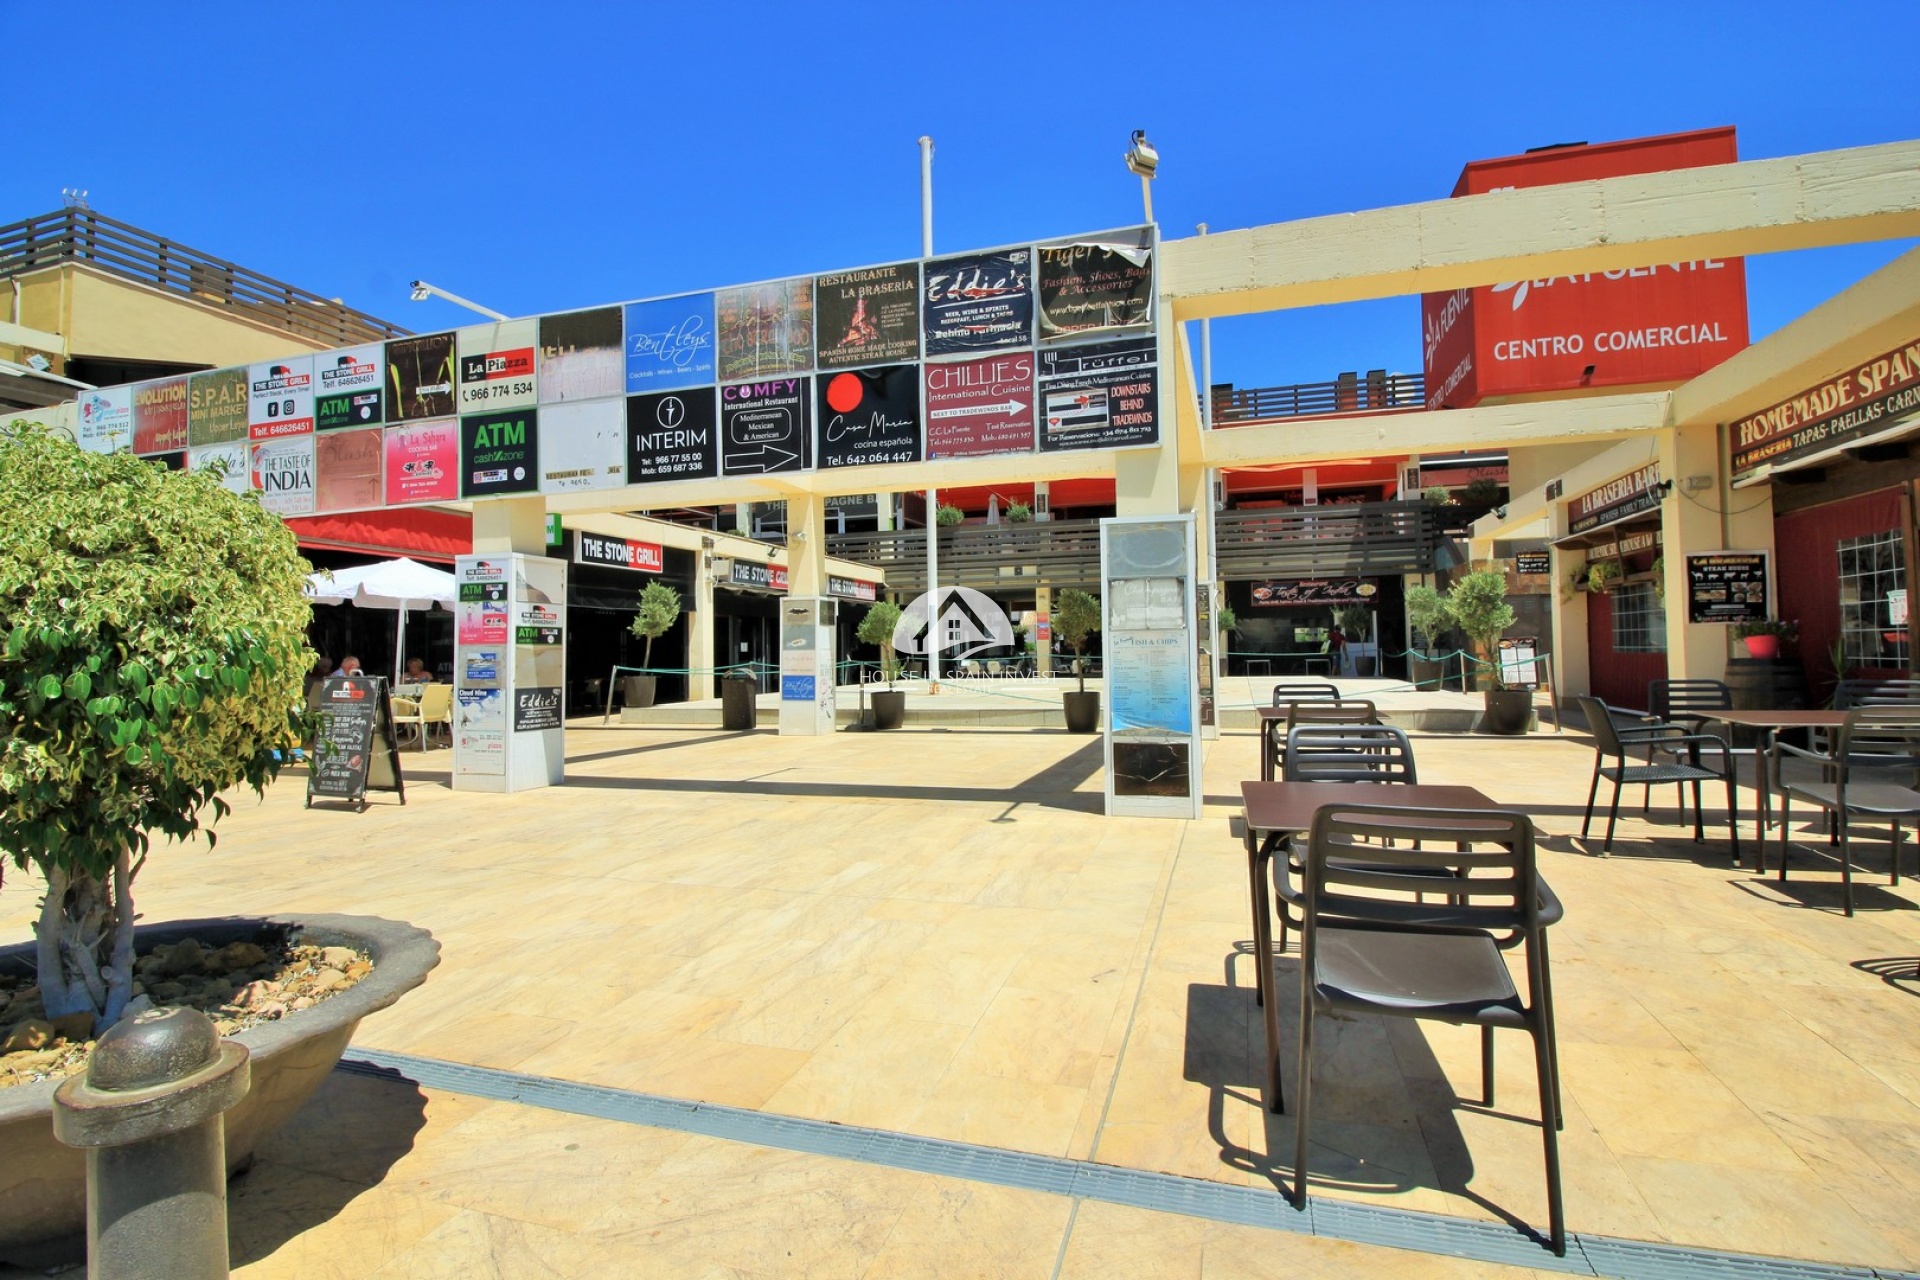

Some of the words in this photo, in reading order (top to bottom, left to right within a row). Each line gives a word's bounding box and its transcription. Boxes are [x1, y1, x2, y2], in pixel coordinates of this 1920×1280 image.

[1042, 245, 1114, 267] Tigers
[819, 267, 896, 287] RESTAURANTE
[928, 268, 1025, 301] Eddie's
[1090, 271, 1121, 283] Shoes,
[841, 287, 855, 299] LA
[1059, 288, 1068, 296] &
[1070, 280, 1133, 295] Accessories
[629, 315, 711, 366] Bentleys
[1494, 334, 1584, 361] CENTRO
[1594, 322, 1728, 352] COMERCIAL
[323, 371, 335, 380] THE
[336, 368, 355, 378] STONE
[356, 364, 373, 373] GRILL
[468, 363, 485, 374] La
[487, 357, 528, 372] Piazza
[928, 359, 1031, 390] CHILLIES
[1445, 352, 1472, 397] COMERCIAL
[254, 381, 267, 391] THE
[268, 379, 289, 390] STONE
[289, 375, 308, 385] GRILL
[724, 379, 797, 400] COMFY
[1111, 382, 1151, 398] DOWNSTAIRS
[471, 388, 489, 401] 966
[492, 385, 510, 398] 774
[513, 382, 533, 395] 534
[929, 385, 989, 403] International
[991, 383, 1031, 397] Cuisine
[320, 398, 350, 417] ATM
[724, 399, 763, 411] International
[764, 396, 798, 406] Restaurant
[959, 406, 999, 415] TRADEWINDS
[1119, 398, 1144, 411] BEHIND
[1740, 376, 1855, 447] HOMEMADE
[191, 408, 209, 421] MINI
[210, 403, 247, 418] MARKET
[739, 411, 782, 422] Mediterranean
[1112, 411, 1153, 426] TRADEWINDS
[254, 427, 269, 437] Telf.
[270, 421, 310, 435] 646626451
[748, 421, 774, 431] Mexican
[410, 435, 419, 445] La
[422, 431, 446, 444] Sahara
[474, 420, 525, 449] ATM
[636, 428, 707, 452] INTERIM
[751, 431, 779, 440] American
[854, 441, 878, 449] cocina
[879, 436, 913, 447] española
[641, 456, 653, 466] Tel:
[655, 455, 669, 465] 966
[671, 454, 680, 463] 77
[681, 453, 691, 462] 55
[692, 452, 702, 461] 00
[827, 455, 844, 466] Tel.
[847, 455, 866, 465] 642
[868, 454, 890, 463] 064
[892, 452, 913, 463] 447
[1736, 454, 1746, 468] LA
[1748, 438, 1792, 463] BRASERIA
[265, 458, 277, 471] THE
[279, 455, 299, 470] TASTE
[301, 454, 311, 468] OF
[641, 466, 657, 475] Mob:
[658, 465, 673, 474] 659
[675, 463, 687, 472] 687
[265, 470, 311, 492] INDIA
[1581, 494, 1592, 514] LA
[1592, 475, 1634, 509] BRASERIA
[766, 500, 787, 511] THE
[583, 538, 603, 558] THE
[605, 541, 635, 562] STONE
[636, 547, 660, 566] GRILL
[734, 564, 749, 579] THE
[752, 566, 774, 582] STONE
[463, 585, 481, 595] ATM
[831, 578, 841, 590] THE
[842, 580, 859, 594] STONE
[860, 582, 872, 596] GRILL
[519, 628, 538, 637] ATM
[520, 694, 557, 708] Eddie's
